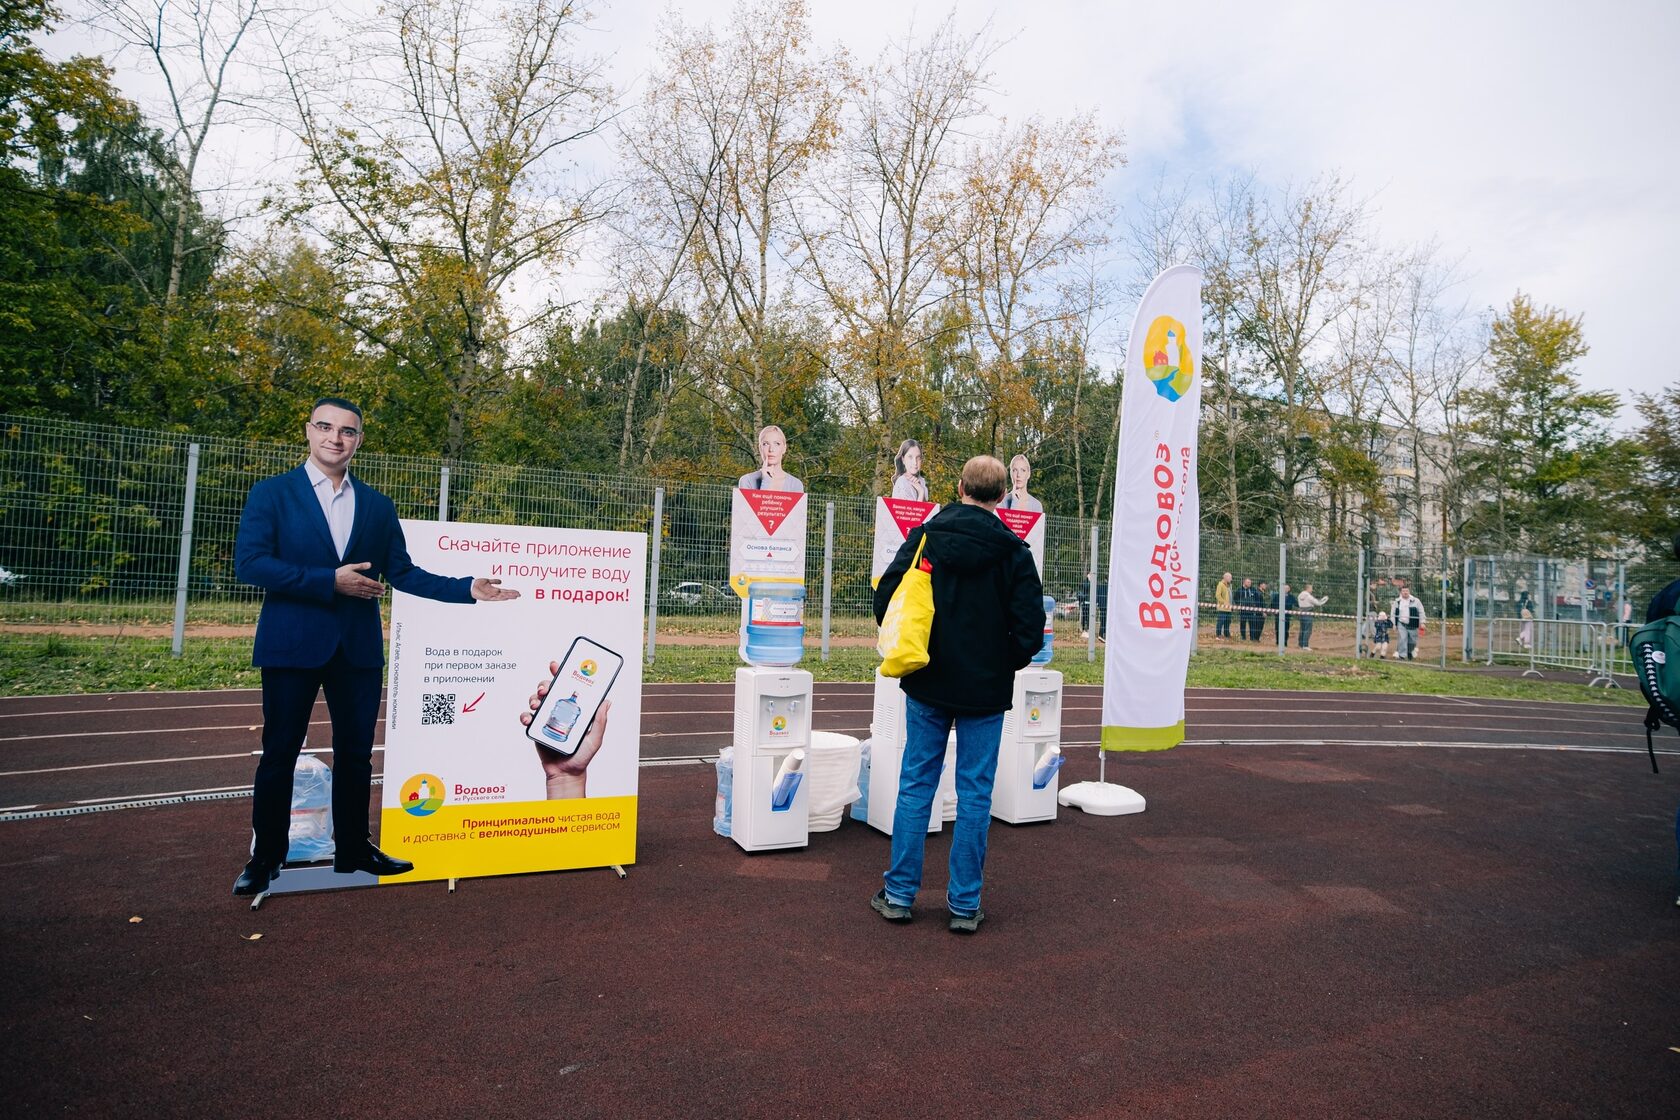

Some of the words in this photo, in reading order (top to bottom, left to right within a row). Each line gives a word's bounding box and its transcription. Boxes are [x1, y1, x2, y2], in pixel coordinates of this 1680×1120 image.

[1181, 447, 1190, 495] села
[769, 520, 775, 529] ?
[1139, 443, 1175, 629] Водовоз
[438, 535, 521, 554] Скачайте
[526, 542, 631, 558] приложение
[492, 564, 502, 576] и
[508, 564, 587, 580] получите
[592, 568, 631, 584] воду
[535, 588, 545, 600] в
[551, 588, 630, 604] подарок!
[1180, 607, 1192, 629] из
[425, 647, 451, 657] Вода
[462, 649, 503, 657] подарок
[424, 662, 443, 670] при
[445, 662, 483, 670] первом
[485, 662, 517, 670] заказе
[432, 676, 495, 684] приложении
[454, 784, 506, 796] Водовоз
[462, 794, 490, 802] Русского
[462, 816, 555, 830] Принципиально
[558, 813, 593, 822] чистая
[595, 811, 621, 821] вода
[403, 835, 411, 843] и
[413, 832, 466, 844] доставка
[469, 831, 475, 839] с
[479, 825, 568, 838] великодушным
[570, 822, 620, 833] сервисом
